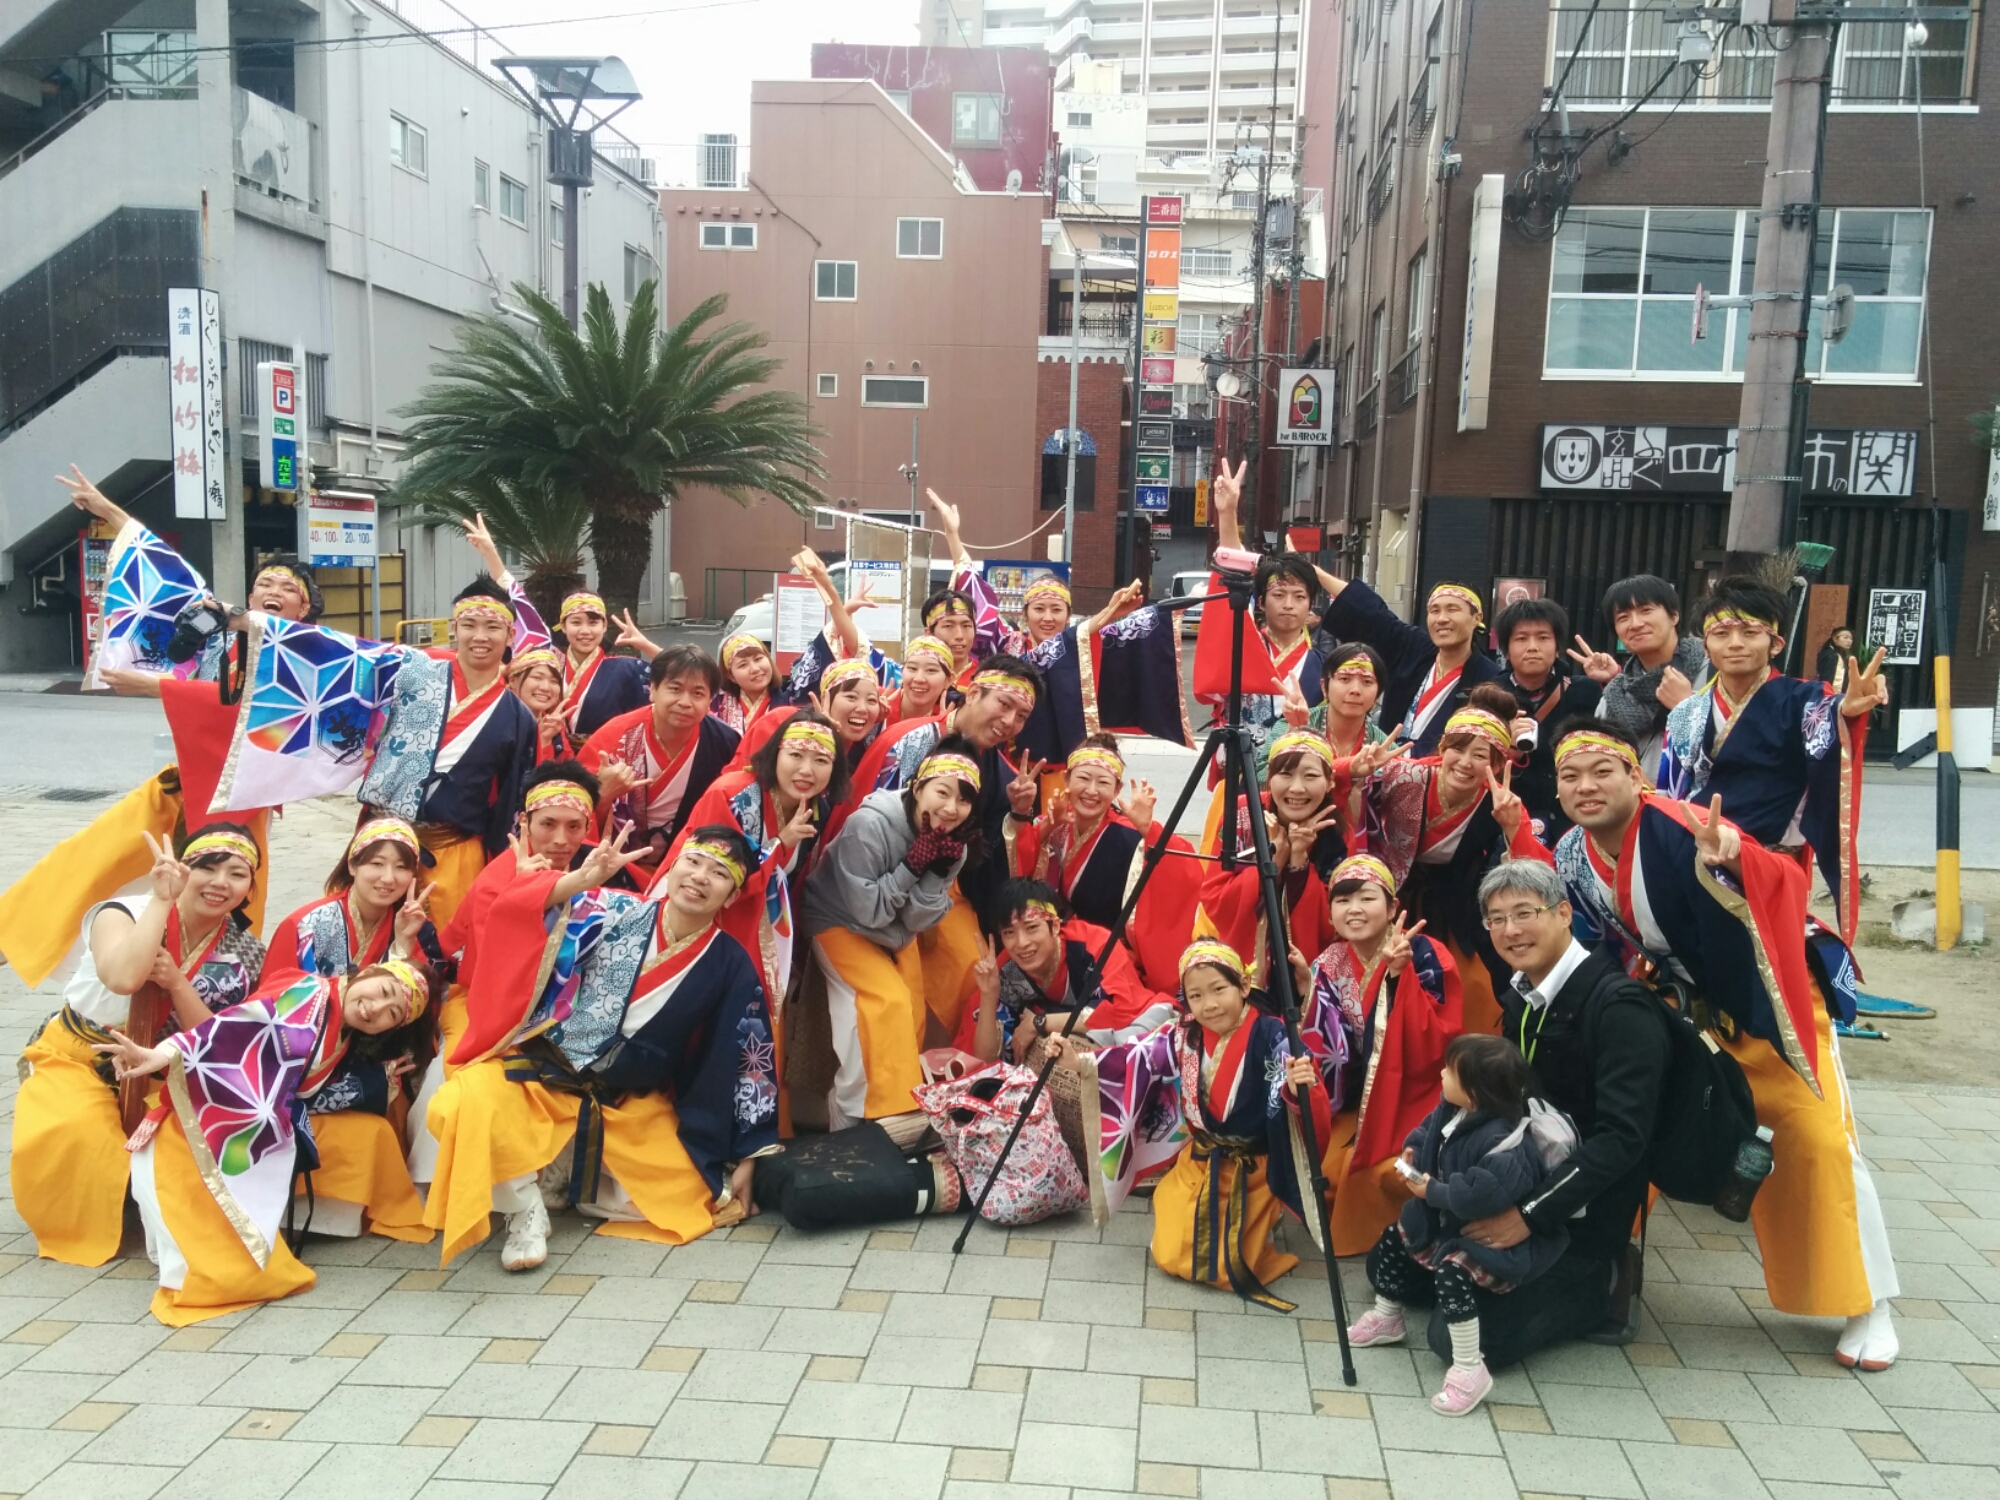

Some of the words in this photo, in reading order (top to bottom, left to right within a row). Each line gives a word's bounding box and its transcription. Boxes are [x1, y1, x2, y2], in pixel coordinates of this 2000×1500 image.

[1150, 203, 1180, 216] 二番館
[1148, 249, 1178, 259] 501
[177, 306, 192, 336] 清酒
[279, 390, 289, 404] P
[172, 355, 203, 476] 松竹梅
[277, 455, 293, 485] 空
